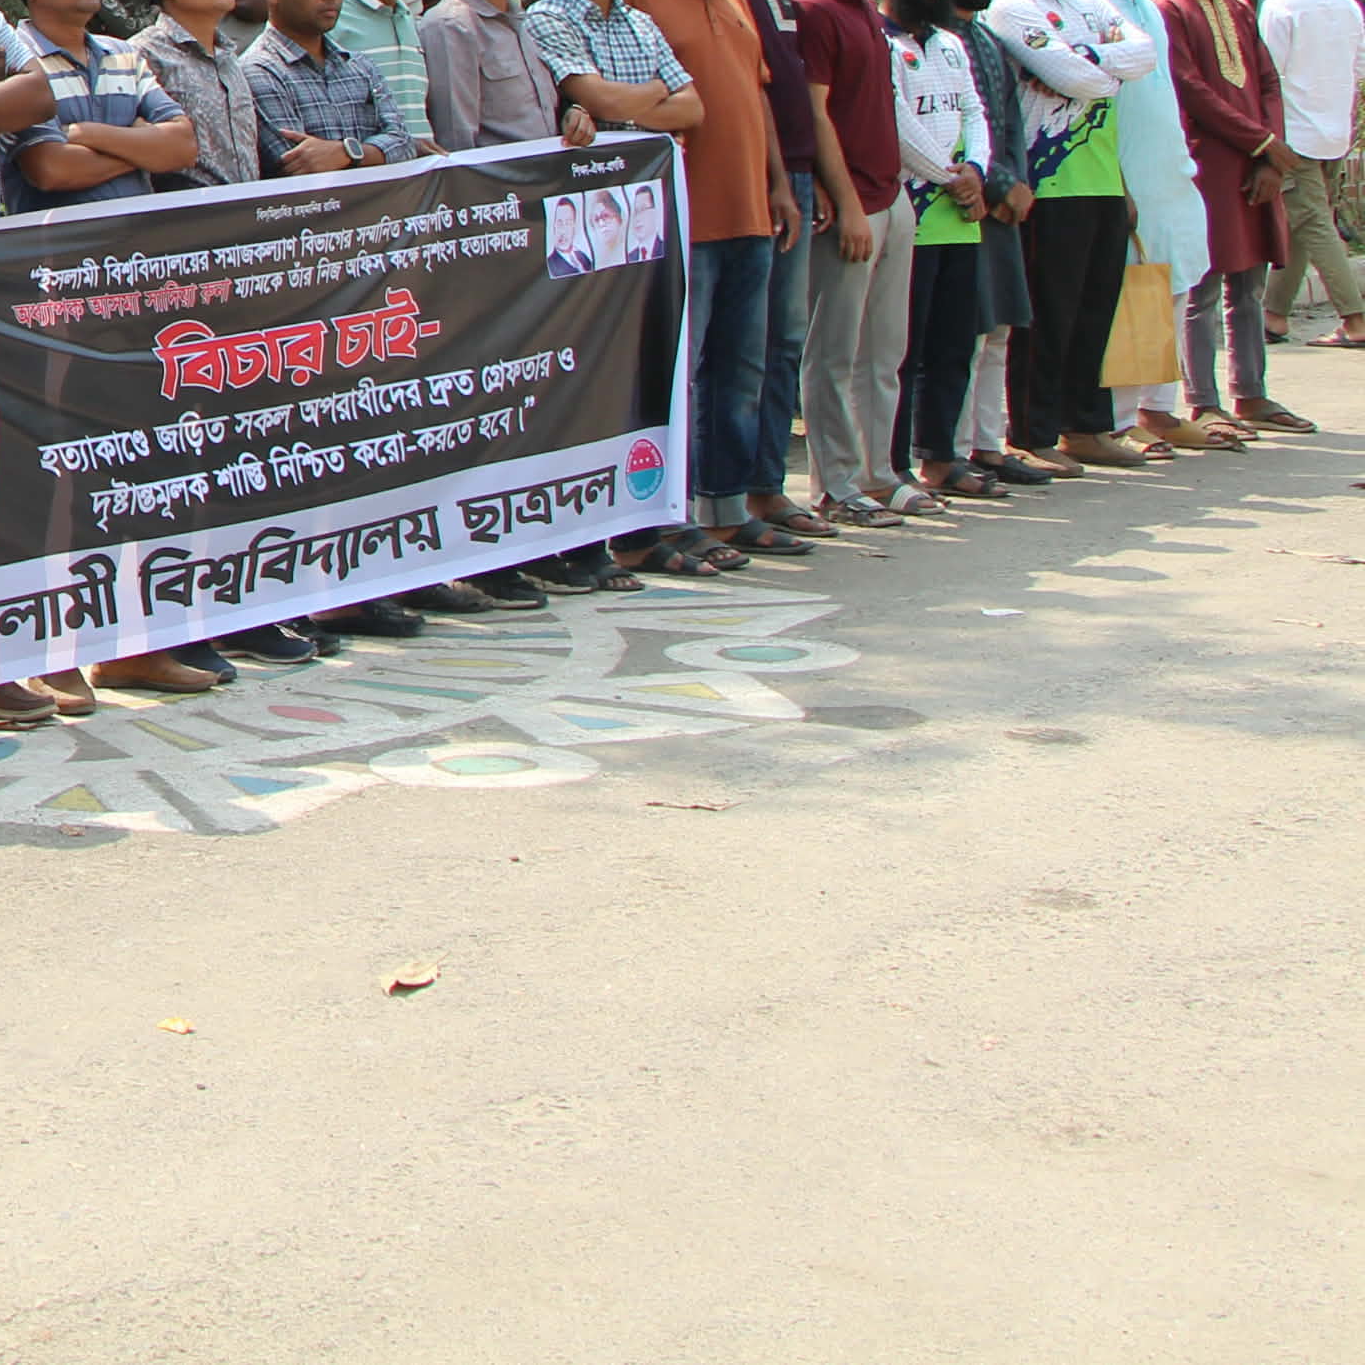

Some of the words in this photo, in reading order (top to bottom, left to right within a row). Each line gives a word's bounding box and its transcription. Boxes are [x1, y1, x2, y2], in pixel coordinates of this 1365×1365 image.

[12, 297, 85, 329] অধ্যাপক
[86, 291, 141, 320] আসমা
[234, 271, 283, 299] ম্যামকে
[288, 260, 314, 290] তাঁর
[316, 257, 344, 285] নিজ
[345, 250, 386, 279] অফিস
[389, 247, 419, 270] কক্ষে
[421, 240, 458, 273] নৃশংস
[460, 227, 531, 259] হত্যাকাণ্ডের
[103, 250, 210, 287] বিশ্ববিদ্যালয়ের
[212, 236, 297, 269] সমাজকল্যাণ
[300, 228, 354, 259] বিভাগের
[355, 215, 402, 247] সম্মানিত
[404, 203, 454, 236] সভাপতি
[456, 205, 469, 220] ও
[470, 192, 521, 226] সহকারী
[37, 429, 150, 478] হত্যাকাণ্ডে
[153, 411, 230, 456] জড়িত
[233, 403, 294, 440] সকল
[299, 377, 422, 428] অপরাধীদের
[425, 369, 475, 408] দ্রুত
[481, 350, 554, 394] গ্রেফতার
[557, 347, 575, 372] ও
[152, 319, 328, 400] বিচার
[90, 471, 209, 533] দৃষ্টান্তমূলক
[213, 452, 267, 498] শাস্তি
[268, 441, 345, 488] নিশ্চিত
[350, 417, 475, 469] করো-করতে
[138, 504, 442, 617] বিশ্ববিদ্যালয়
[455, 463, 619, 544] ছাত্রদল
